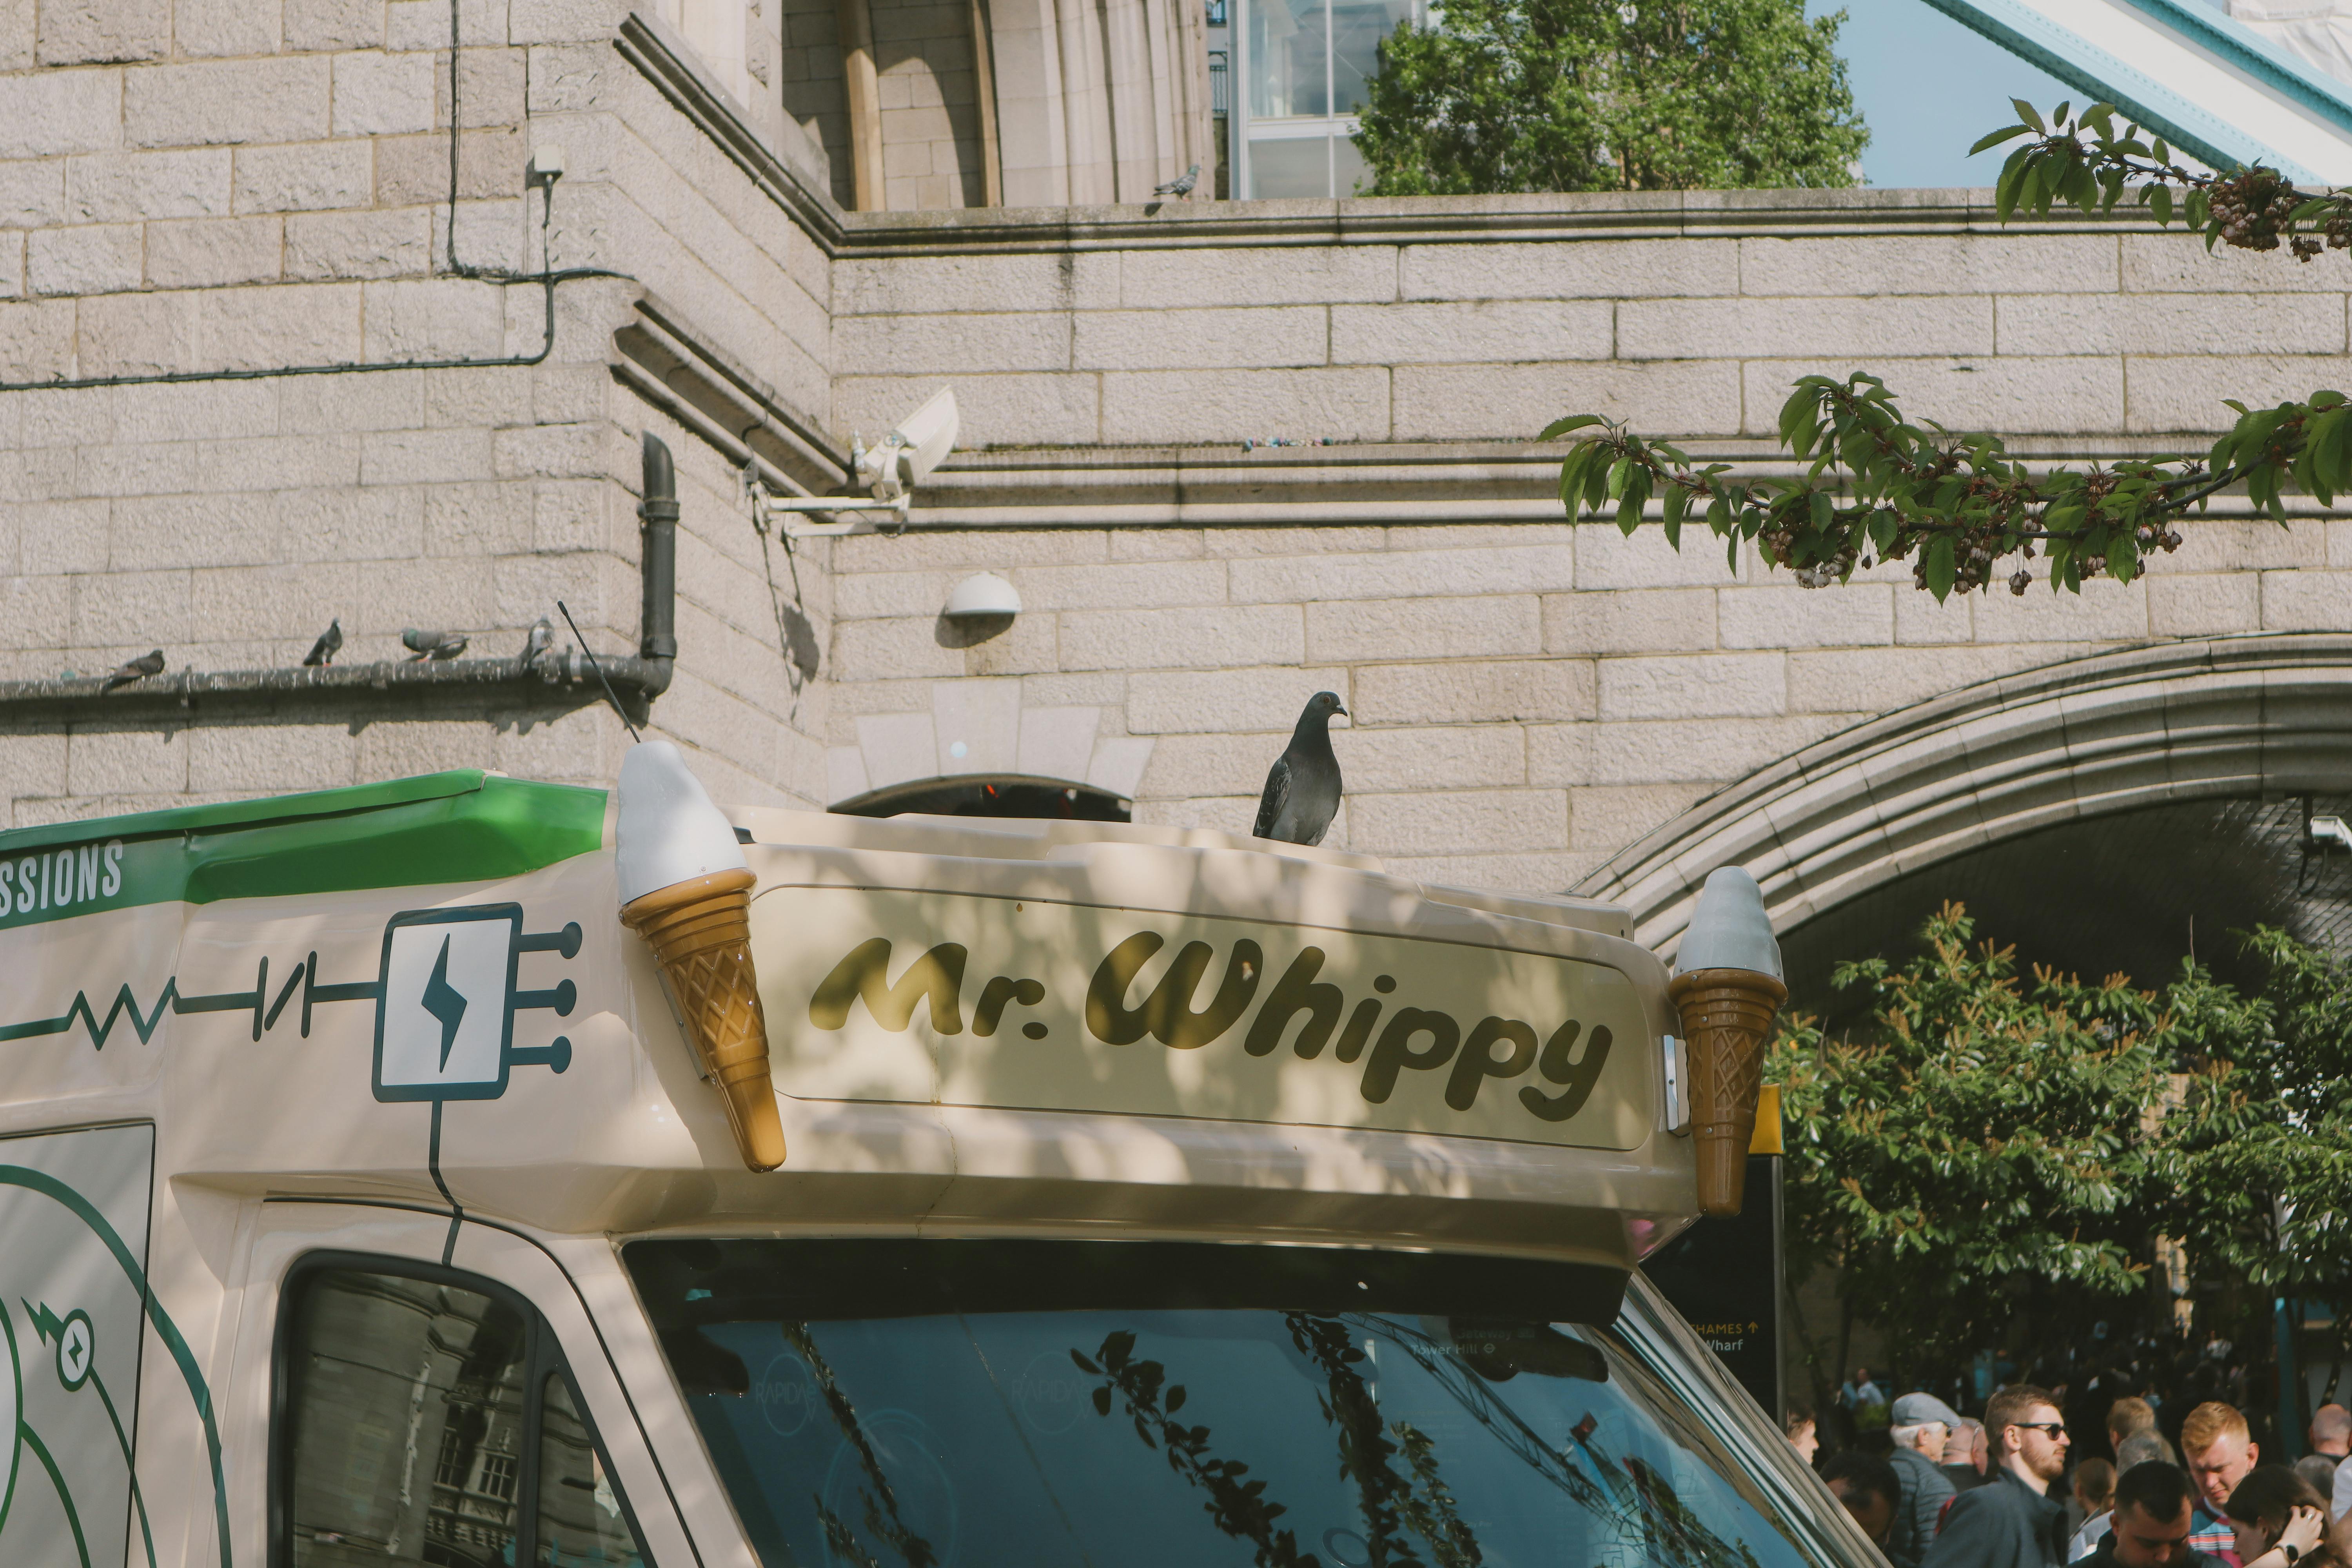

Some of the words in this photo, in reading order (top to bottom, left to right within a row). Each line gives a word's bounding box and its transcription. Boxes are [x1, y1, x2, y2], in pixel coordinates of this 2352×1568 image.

[809, 937, 1048, 1040] Mr.
[1085, 931, 1613, 1122] Whippy
[1412, 1345, 1451, 1355] Tower
[1456, 1344, 1477, 1355] Hill
